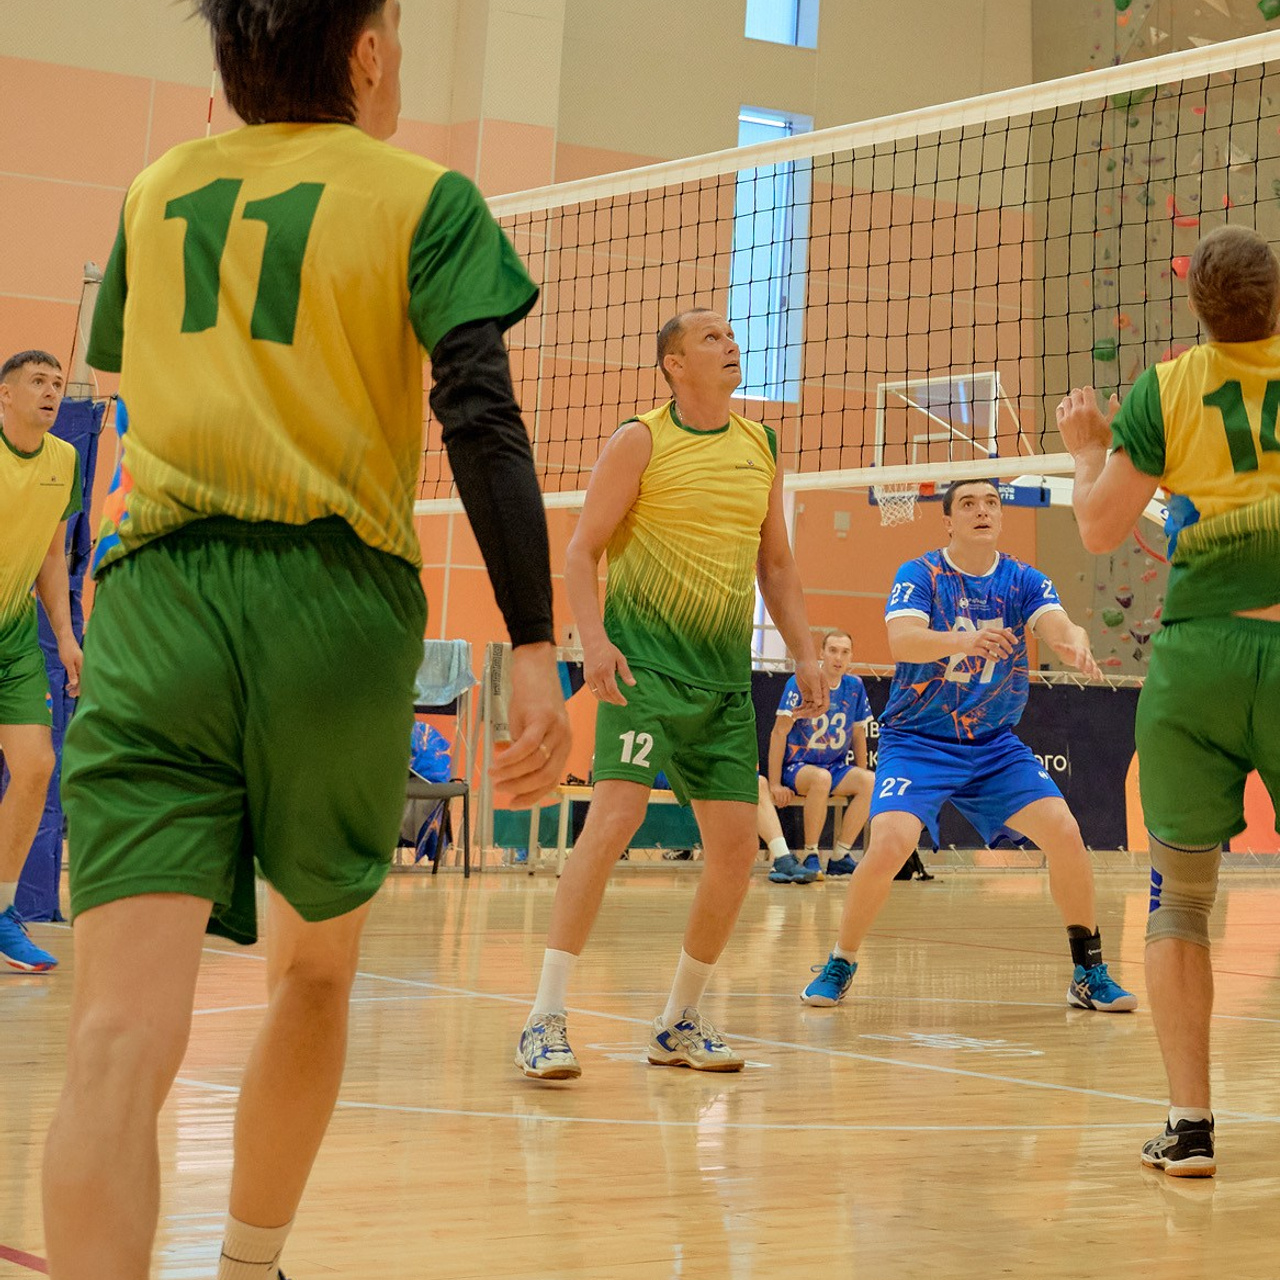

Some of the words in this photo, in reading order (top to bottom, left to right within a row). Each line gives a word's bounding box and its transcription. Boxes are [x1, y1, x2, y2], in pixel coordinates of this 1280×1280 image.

[164, 178, 326, 346] 11
[890, 582, 915, 606] 27
[1041, 579, 1060, 599] 2
[807, 712, 846, 750] 23
[619, 730, 653, 768] 12
[879, 777, 912, 799] 27
